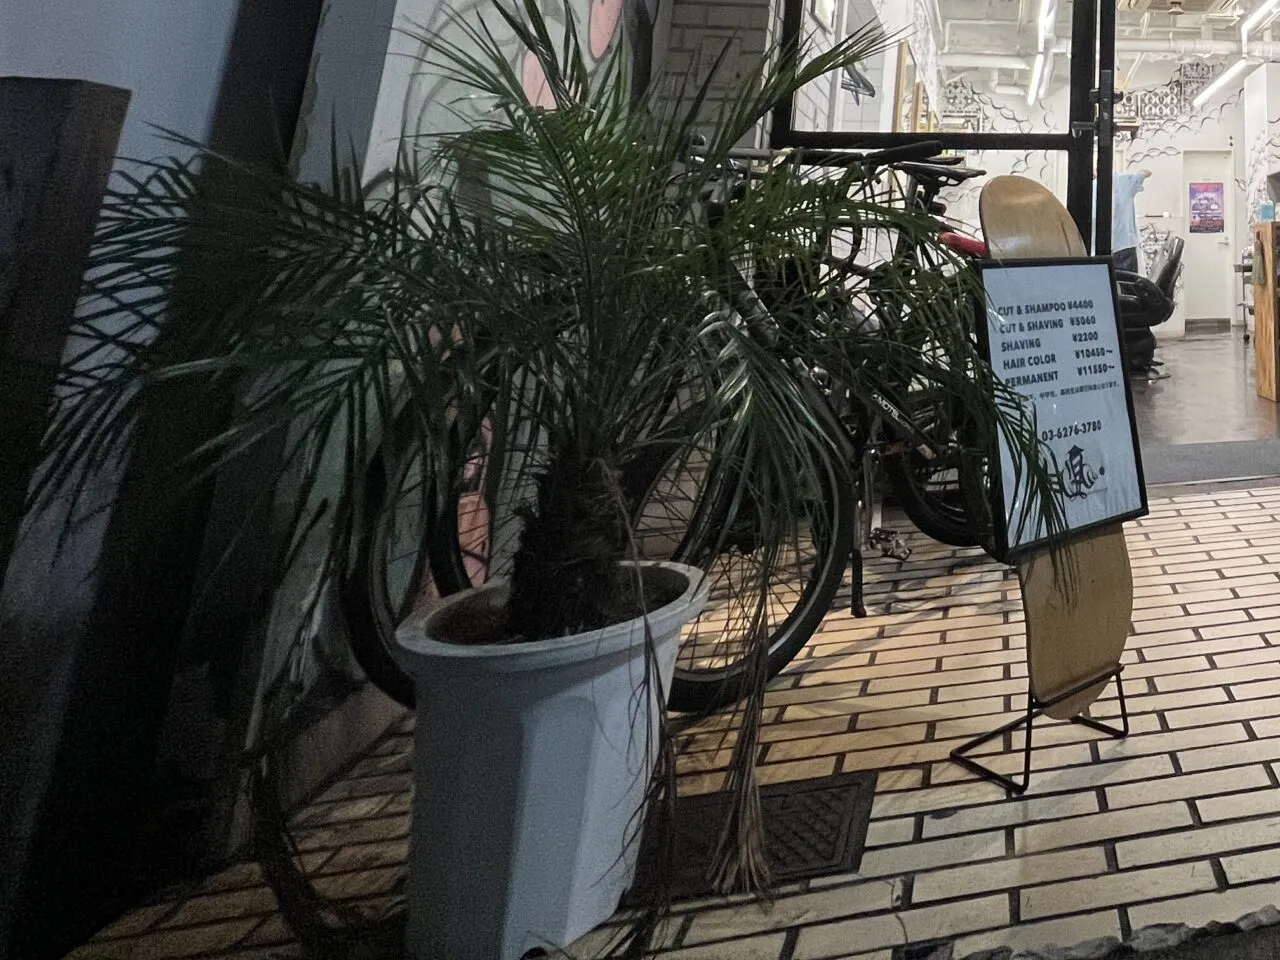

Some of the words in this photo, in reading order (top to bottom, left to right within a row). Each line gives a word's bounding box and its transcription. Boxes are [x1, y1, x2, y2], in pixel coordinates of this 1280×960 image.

[998, 306, 1013, 315] CUT
[1017, 306, 1023, 315] &
[1025, 302, 1066, 314] SHAMPOO
[1000, 323, 1016, 334] CUT
[1019, 322, 1025, 332] &
[1027, 319, 1064, 332] SHAVING
[1001, 338, 1042, 352] SHAVING
[1003, 358, 1026, 370] HAIR
[1028, 353, 1057, 367] COLOR
[1005, 371, 1059, 387] PERMANENT
[1042, 420, 1102, 441] 03-6276-3780
